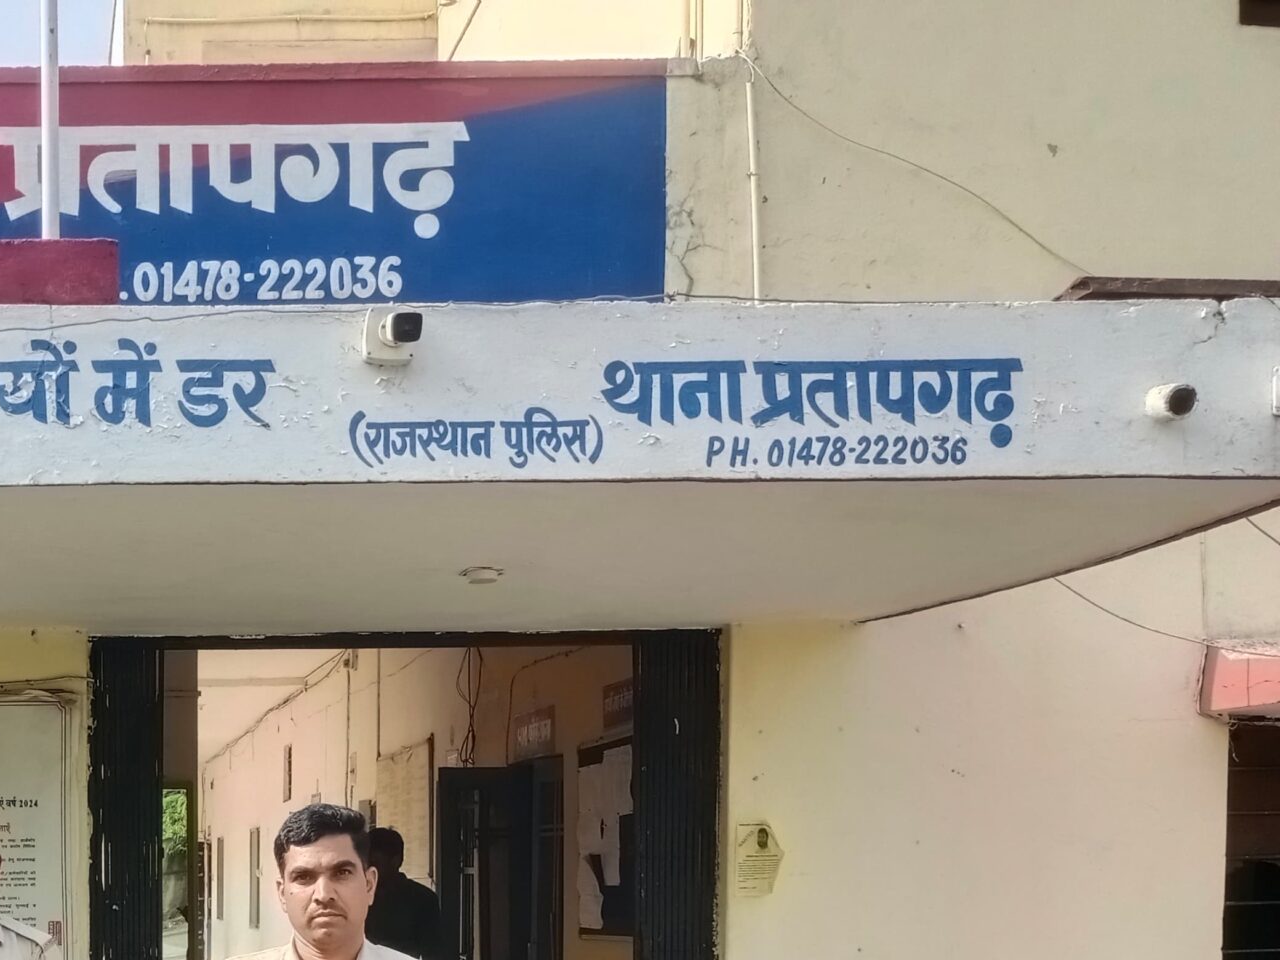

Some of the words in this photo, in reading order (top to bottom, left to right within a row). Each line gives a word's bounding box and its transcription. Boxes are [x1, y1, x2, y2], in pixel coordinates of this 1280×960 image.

[90, 338, 162, 428] में
[174, 357, 278, 430] डर
[600, 358, 748, 427] थाना
[752, 357, 1024, 448] प्रतापगढ़
[348, 411, 496, 468] (राजस्थान
[501, 406, 604, 469] पुलिस)
[706, 440, 759, 468] PH.
[767, 435, 968, 469] 01478-222036
[19, 799, 39, 808] 2024
